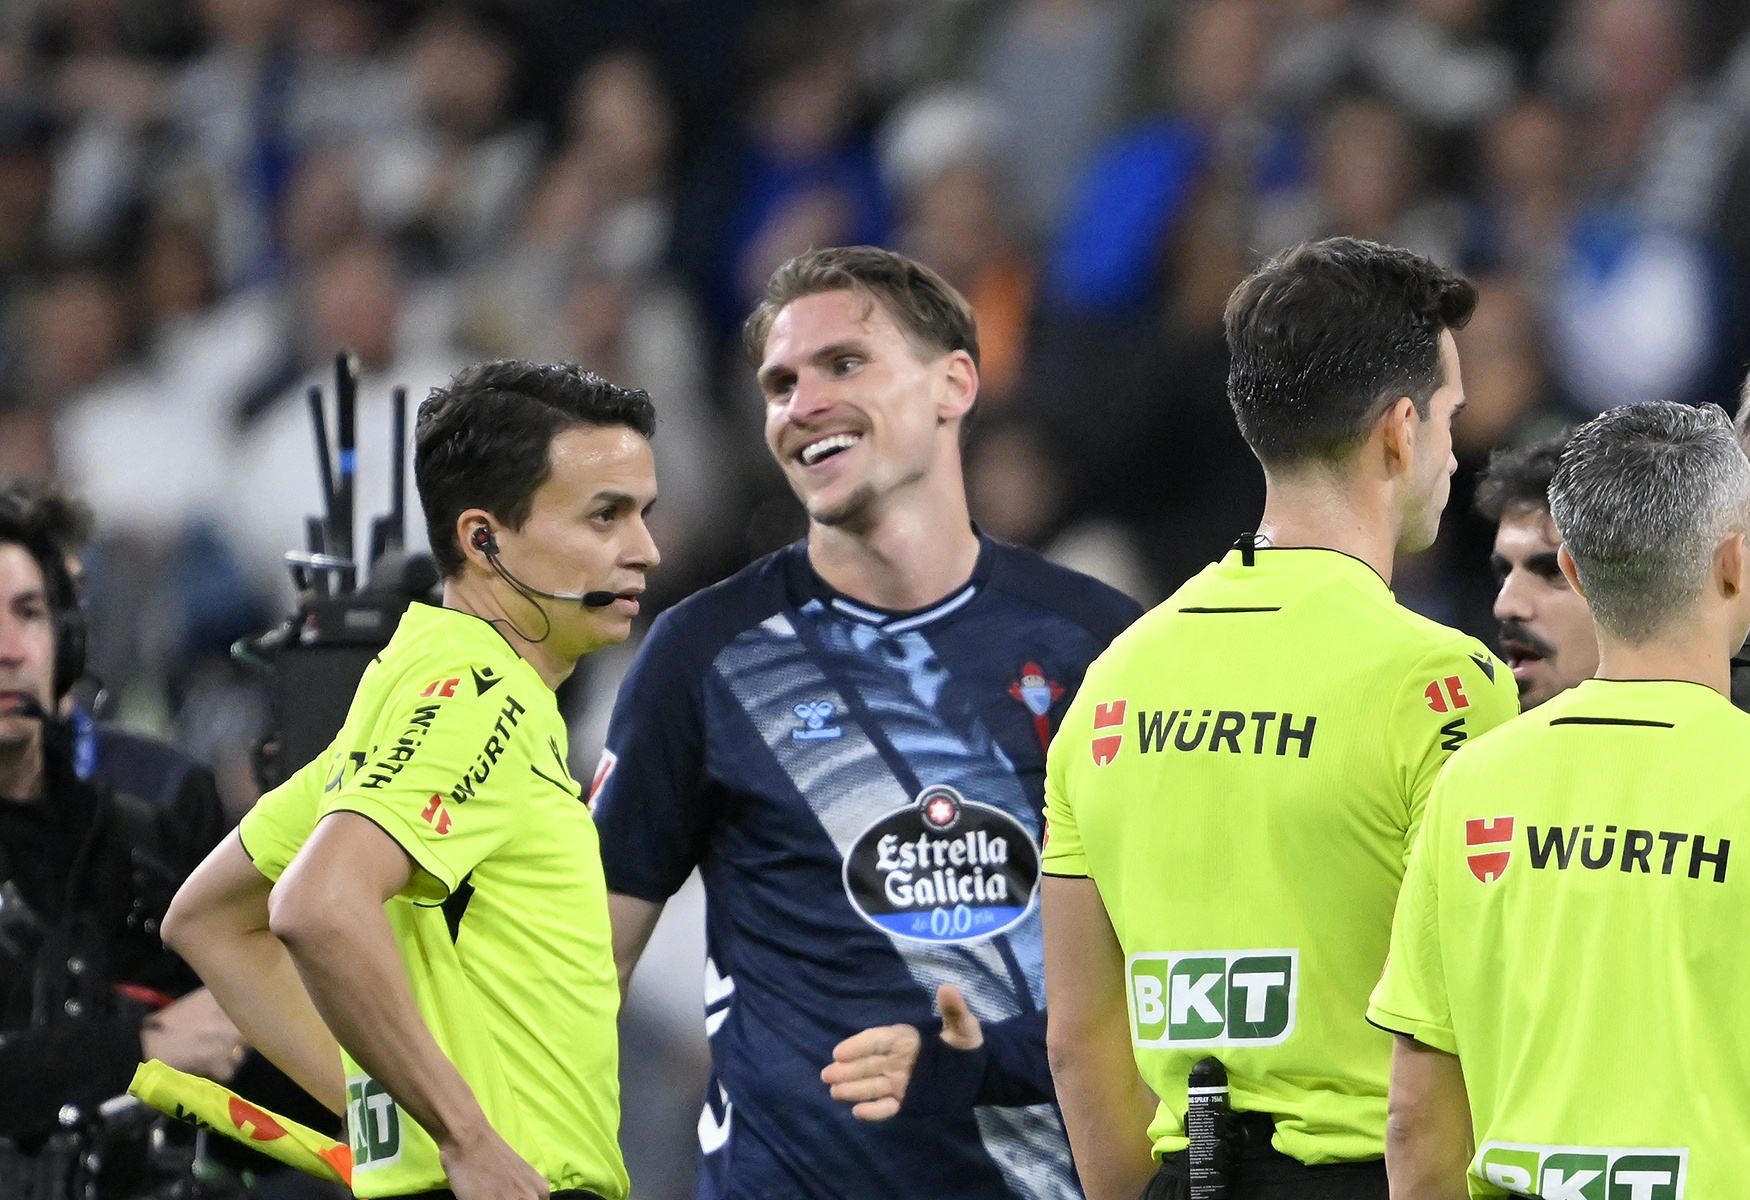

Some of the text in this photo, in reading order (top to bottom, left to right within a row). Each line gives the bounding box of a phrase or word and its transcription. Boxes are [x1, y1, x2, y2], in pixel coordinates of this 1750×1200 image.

[450, 695, 526, 805] WÜRTH
[1138, 710, 1317, 759] WÜRTH
[875, 829, 1008, 871] Estrella
[1527, 824, 1731, 884] WÜRTH
[884, 866, 1008, 908] Galicia
[1134, 970, 1289, 1026] BKT
